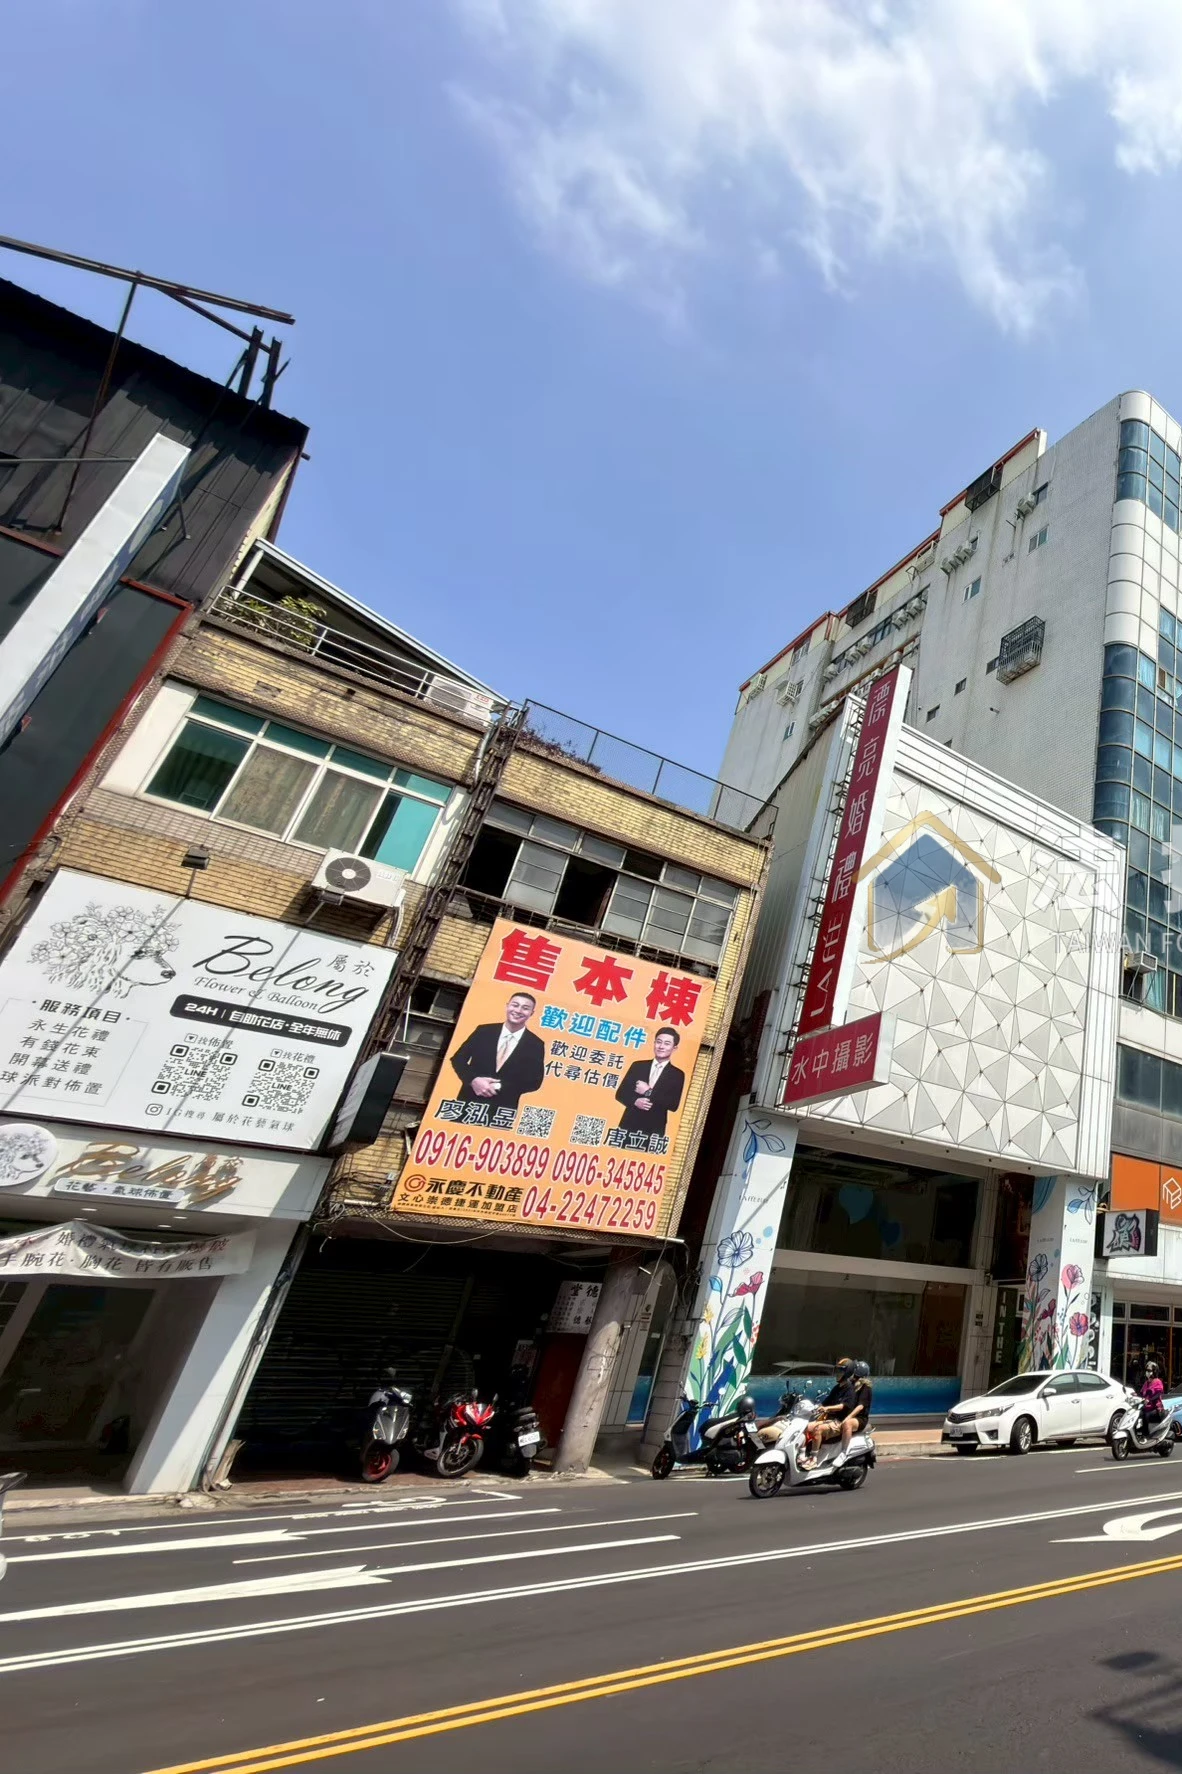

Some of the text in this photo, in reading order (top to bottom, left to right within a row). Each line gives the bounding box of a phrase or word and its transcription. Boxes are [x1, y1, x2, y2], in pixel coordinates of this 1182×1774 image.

[830, 678, 891, 904] 漂亮婚禮
[192, 936, 370, 1014] Belong
[327, 954, 375, 977] 屬於
[493, 928, 702, 1029] 售本棟
[194, 976, 247, 996] Flower
[267, 992, 318, 1011] Balloon
[40, 999, 121, 1023] 服務項目
[184, 1002, 219, 1016] 24H
[28, 1019, 110, 1041] 永生花禮
[539, 1005, 647, 1049] 歡迎配件
[9, 1053, 92, 1075] 開幕送禮
[550, 1040, 624, 1070] 歡迎委託
[791, 1031, 874, 1086] 水中攝影
[184, 1068, 208, 1078] LINE
[271, 1082, 293, 1091] LINE
[544, 1061, 621, 1089] 代尋估價
[415, 1130, 665, 1195] 0916-903899 0906-345845
[398, 1193, 518, 1213] 文心崇德捷運加盟店
[425, 1177, 524, 1202] 永慶不動產
[522, 1186, 656, 1231] 04-22472259
